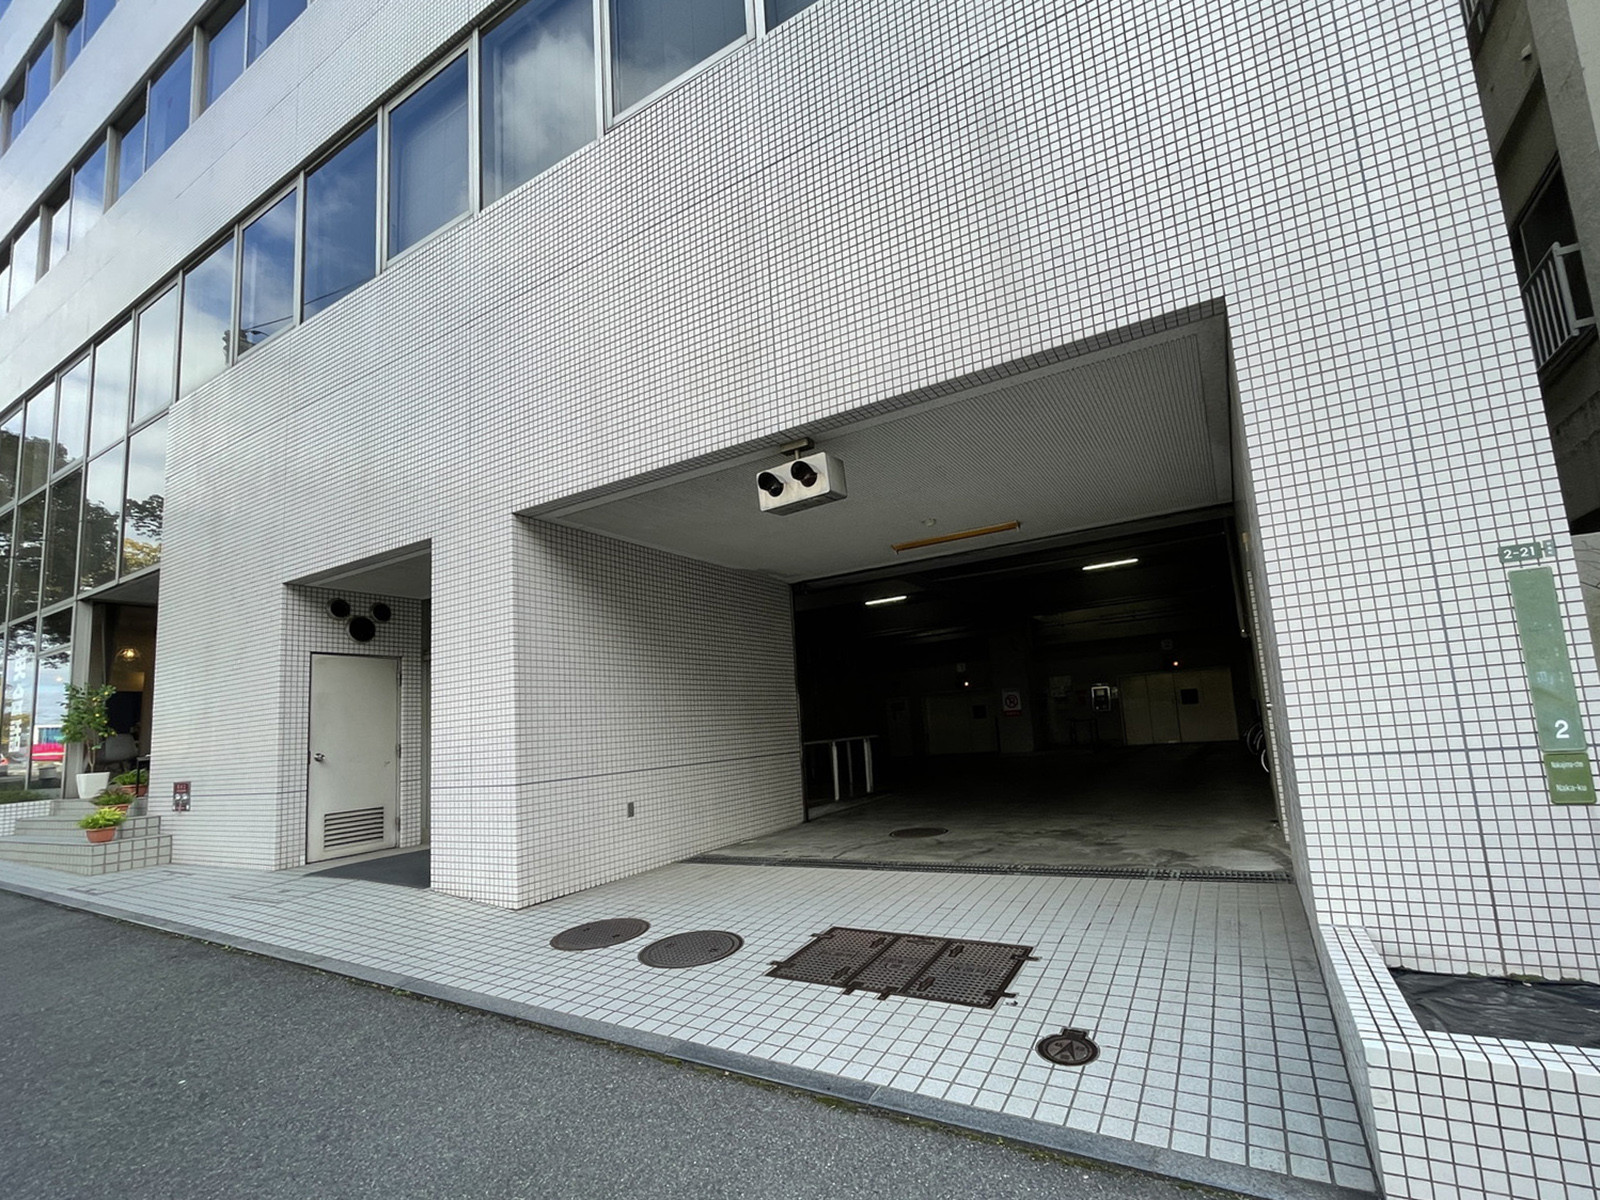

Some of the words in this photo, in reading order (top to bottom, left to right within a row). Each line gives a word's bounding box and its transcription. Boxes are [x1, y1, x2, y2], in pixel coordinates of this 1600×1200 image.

[1503, 546, 1536, 560] 2-21
[1554, 719, 1570, 739] 2
[1555, 784, 1588, 792] Naka-ku
